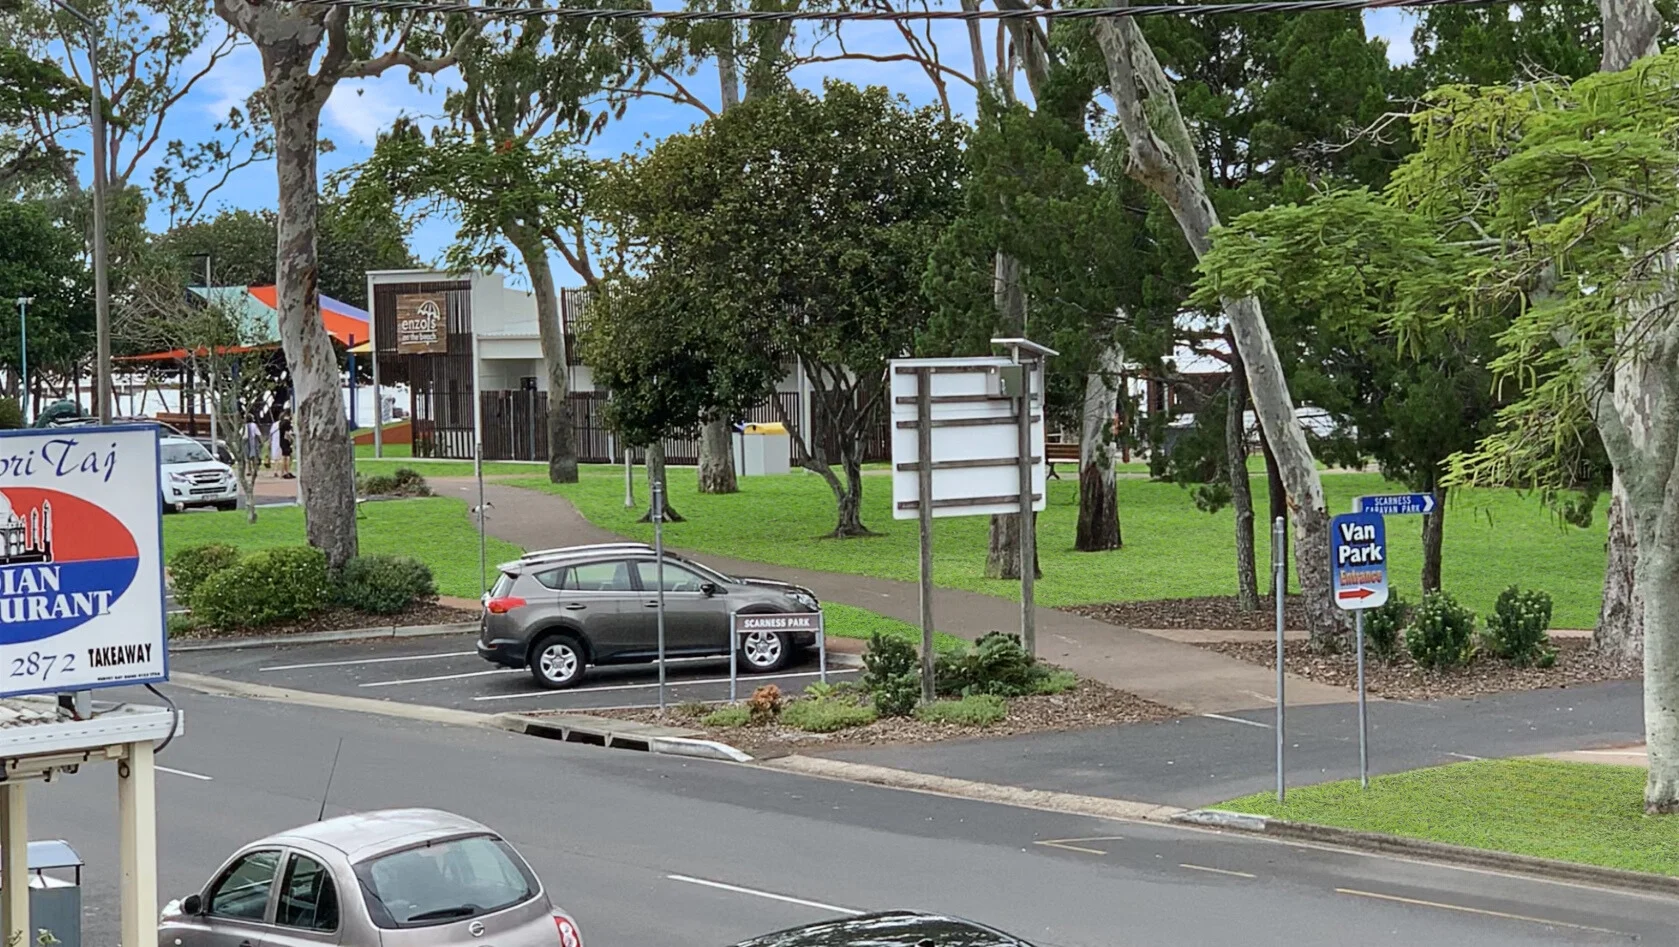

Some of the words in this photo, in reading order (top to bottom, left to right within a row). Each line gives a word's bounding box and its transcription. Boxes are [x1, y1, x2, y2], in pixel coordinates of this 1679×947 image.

[42, 439, 117, 482] Taj
[1375, 495, 1412, 506] SCARNESS
[1401, 503, 1420, 514] PARK
[1341, 523, 1375, 541] Van
[1339, 543, 1383, 564] Park
[0, 566, 61, 595] IAN
[1340, 569, 1383, 586] Entrance
[744, 618, 786, 628] SCARNESS
[787, 618, 810, 627] PARK
[88, 643, 152, 668] TAKEAWAY
[10, 651, 76, 681] 2872
